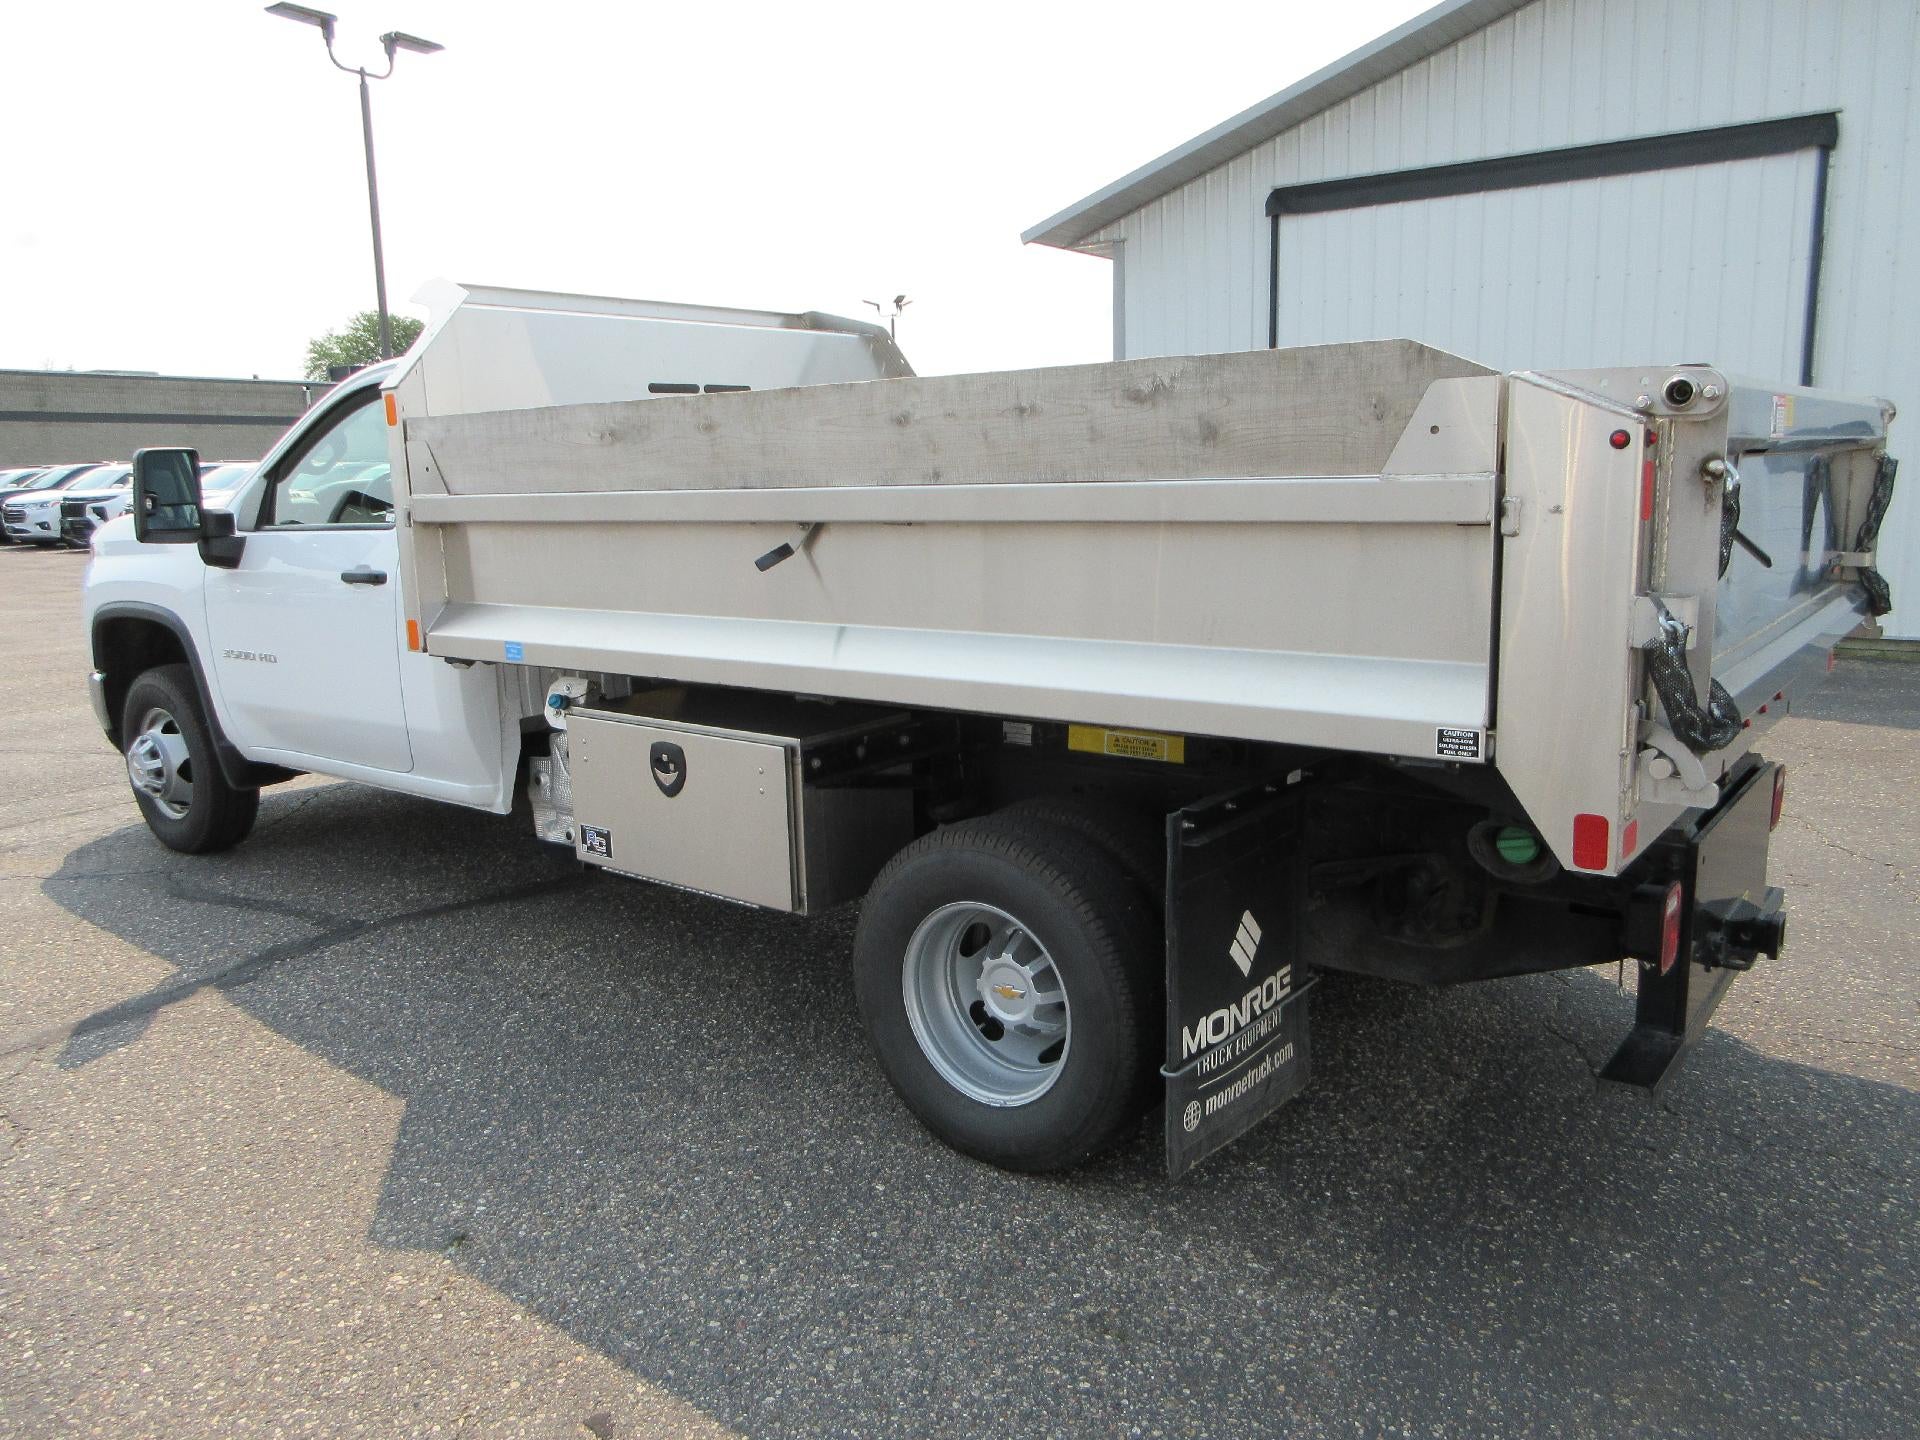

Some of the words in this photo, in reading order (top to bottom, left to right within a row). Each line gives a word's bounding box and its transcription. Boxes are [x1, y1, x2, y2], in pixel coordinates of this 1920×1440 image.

[222, 648, 257, 661] 3500
[259, 652, 279, 664] HD
[1443, 730, 1474, 738] CAUTION
[1182, 963, 1292, 1060] MONROE
[1197, 1044, 1233, 1077] TRUCK
[1235, 1007, 1282, 1056] EQUIPMENT
[1205, 1041, 1294, 1116] monroetruck.com
